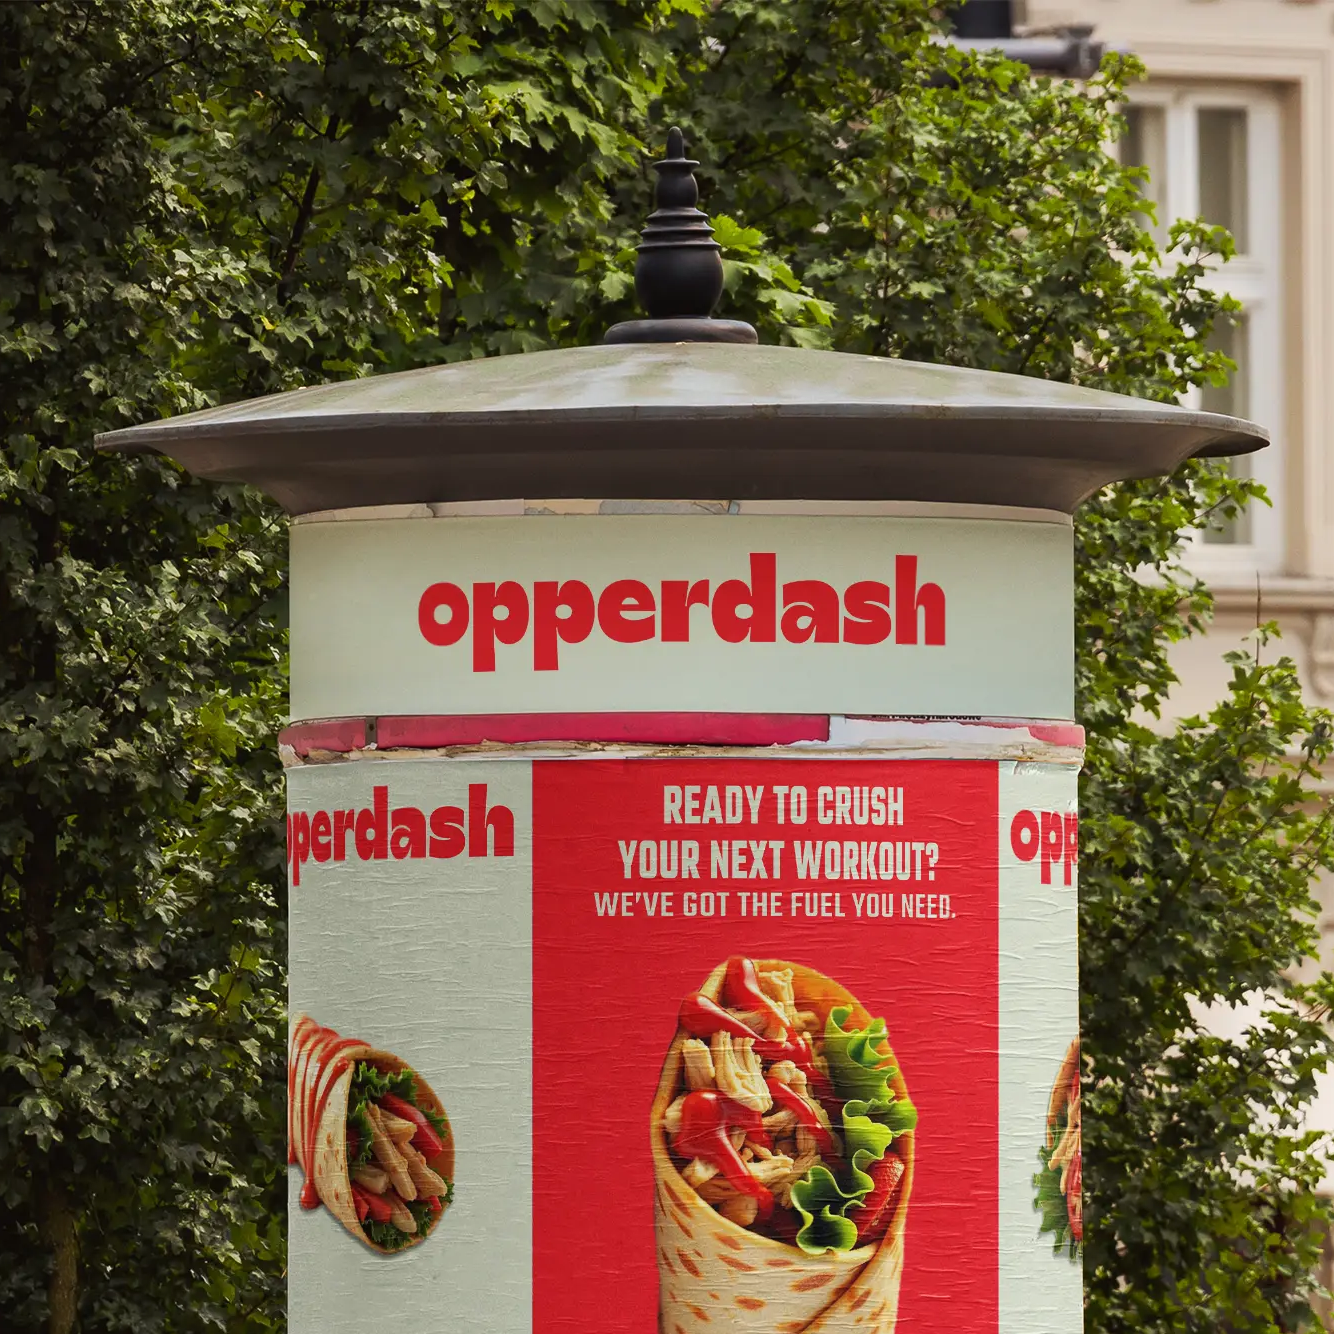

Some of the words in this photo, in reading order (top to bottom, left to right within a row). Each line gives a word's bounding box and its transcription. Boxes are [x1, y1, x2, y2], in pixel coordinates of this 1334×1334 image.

[418, 552, 946, 673] opperdash
[663, 785, 764, 825] READY
[772, 785, 808, 825] TO
[817, 786, 904, 826] CRUSH
[287, 784, 515, 887] perdash
[618, 839, 700, 879] YOUR
[710, 839, 785, 880] NEXT
[793, 840, 939, 881] WORKOUT?
[594, 891, 674, 917] WE'VE
[683, 891, 730, 917] GOT
[737, 891, 783, 917] THE
[791, 892, 846, 917] FUEL
[852, 893, 894, 918] YOU
[901, 893, 956, 919] NEED.
